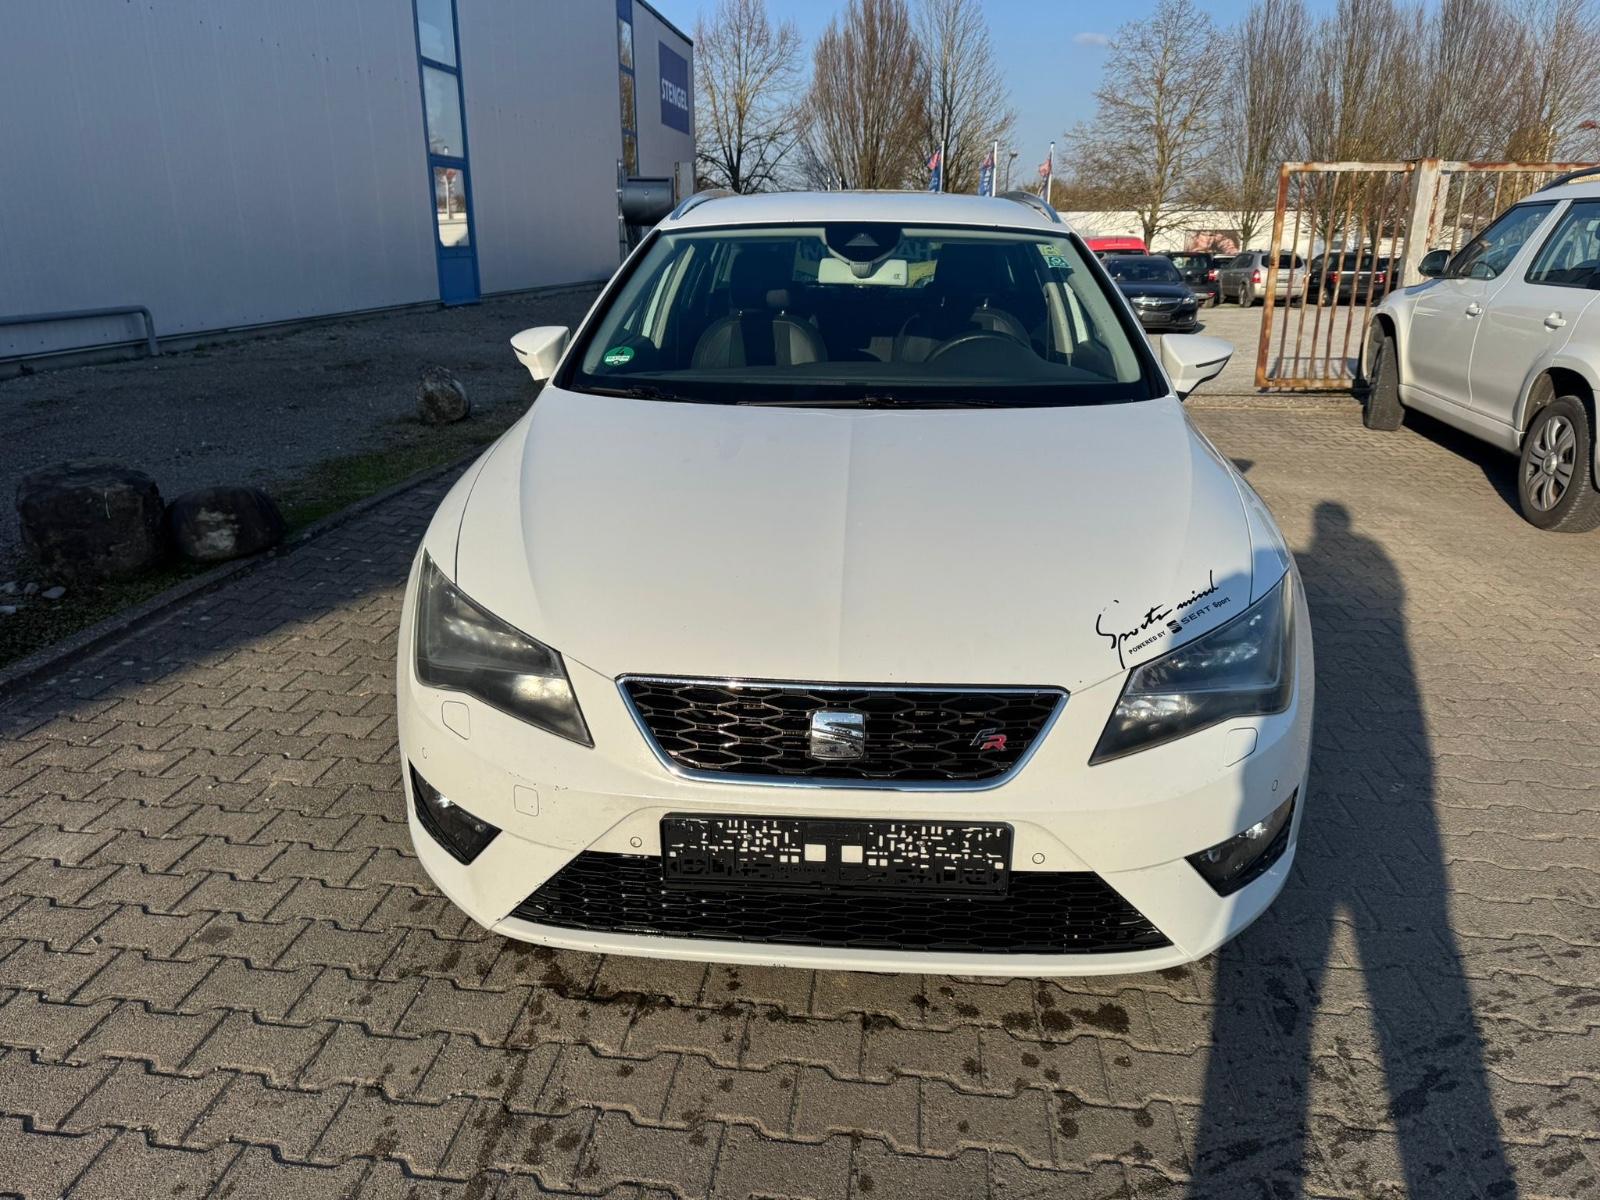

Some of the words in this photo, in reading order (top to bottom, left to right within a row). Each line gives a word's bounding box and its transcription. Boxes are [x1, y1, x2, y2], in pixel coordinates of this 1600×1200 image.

[661, 78, 688, 111] STENGEL
[1176, 569, 1219, 610] mind
[1128, 635, 1158, 655] POWERED
[1158, 630, 1167, 638] BY
[1180, 604, 1211, 625] SEAT
[1212, 596, 1231, 608] Sport
